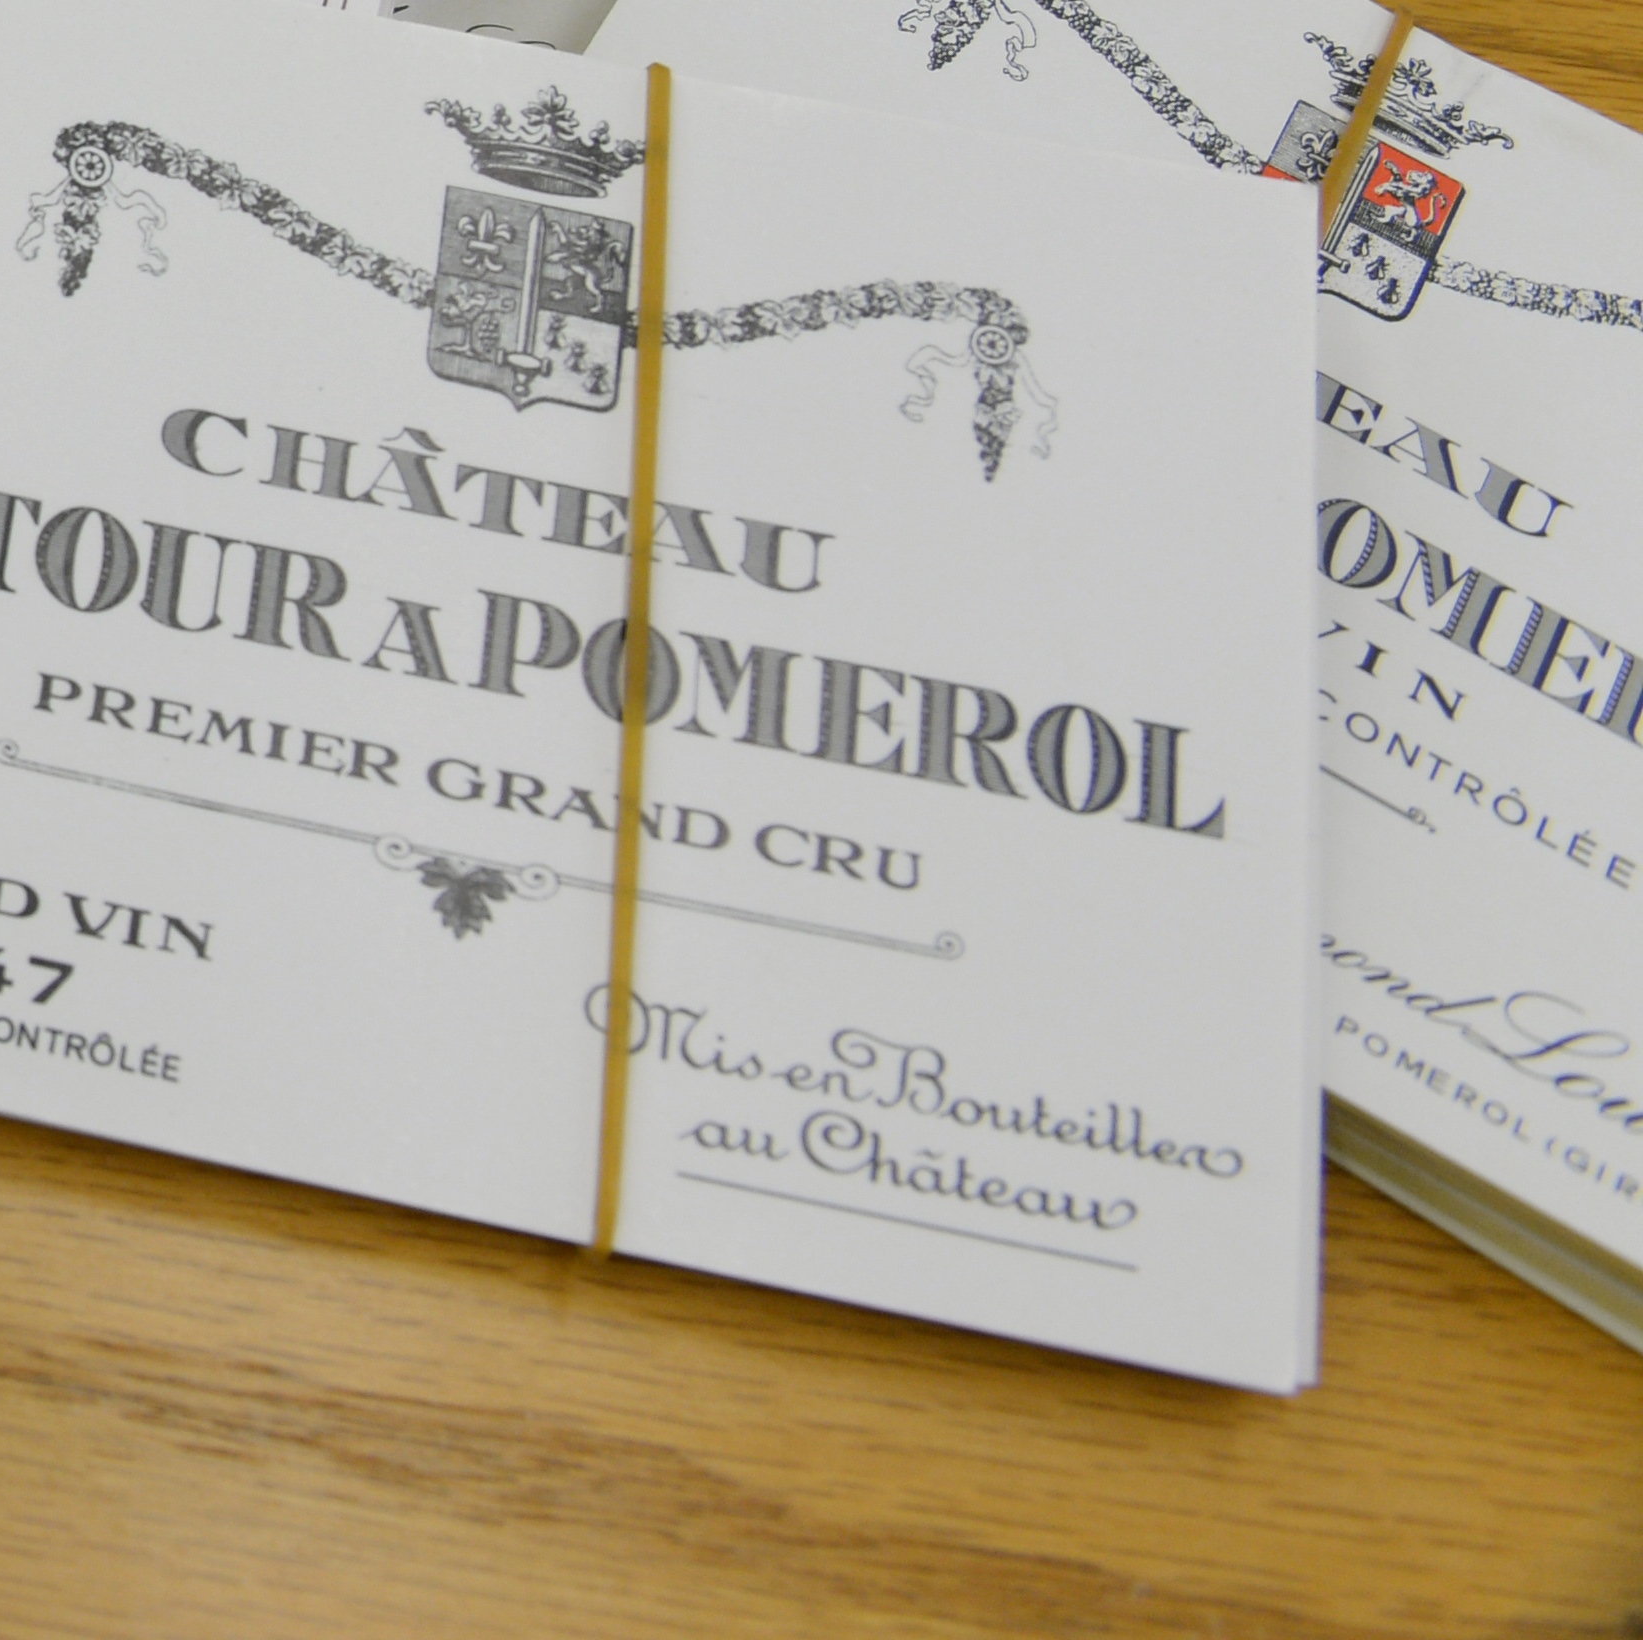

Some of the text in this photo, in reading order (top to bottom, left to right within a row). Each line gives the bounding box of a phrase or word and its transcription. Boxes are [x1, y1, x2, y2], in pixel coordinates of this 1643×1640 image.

[161, 407, 838, 593] CHÂTEAU
[32, 670, 924, 892] PREMIER GRAND CRU
[475, 587, 1229, 841] POMEROL
[62, 891, 219, 961] VIN
[583, 980, 1246, 1181] Mis en Bouteilles
[677, 1108, 1140, 1232] au Château
[1334, 1014, 1531, 1145] POMEROL
